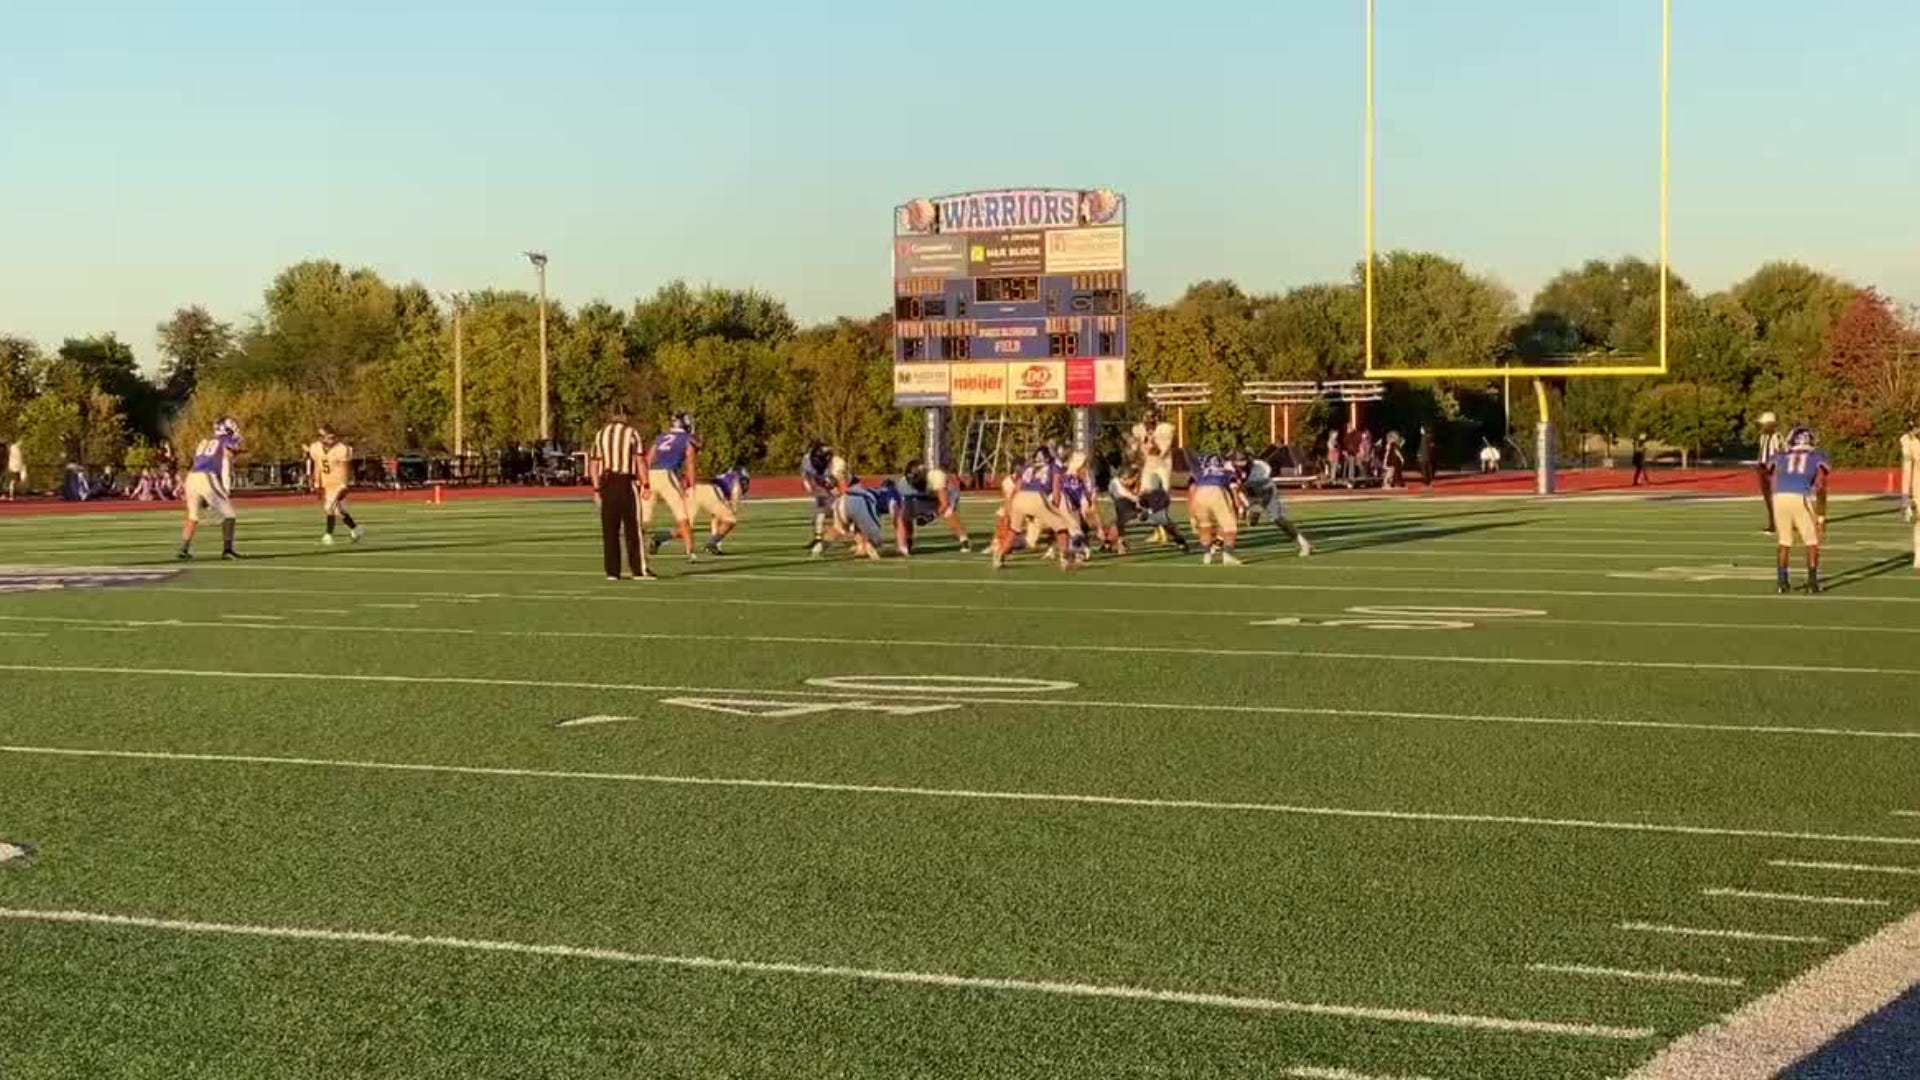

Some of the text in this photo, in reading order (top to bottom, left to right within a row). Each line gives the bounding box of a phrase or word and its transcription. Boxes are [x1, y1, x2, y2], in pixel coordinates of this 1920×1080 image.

[942, 195, 1075, 229] WARRIORS
[952, 374, 1004, 395] meijer
[657, 434, 677, 451] 2
[321, 459, 331, 474] 5
[1787, 453, 1808, 474] 11
[660, 675, 1079, 717] 40
